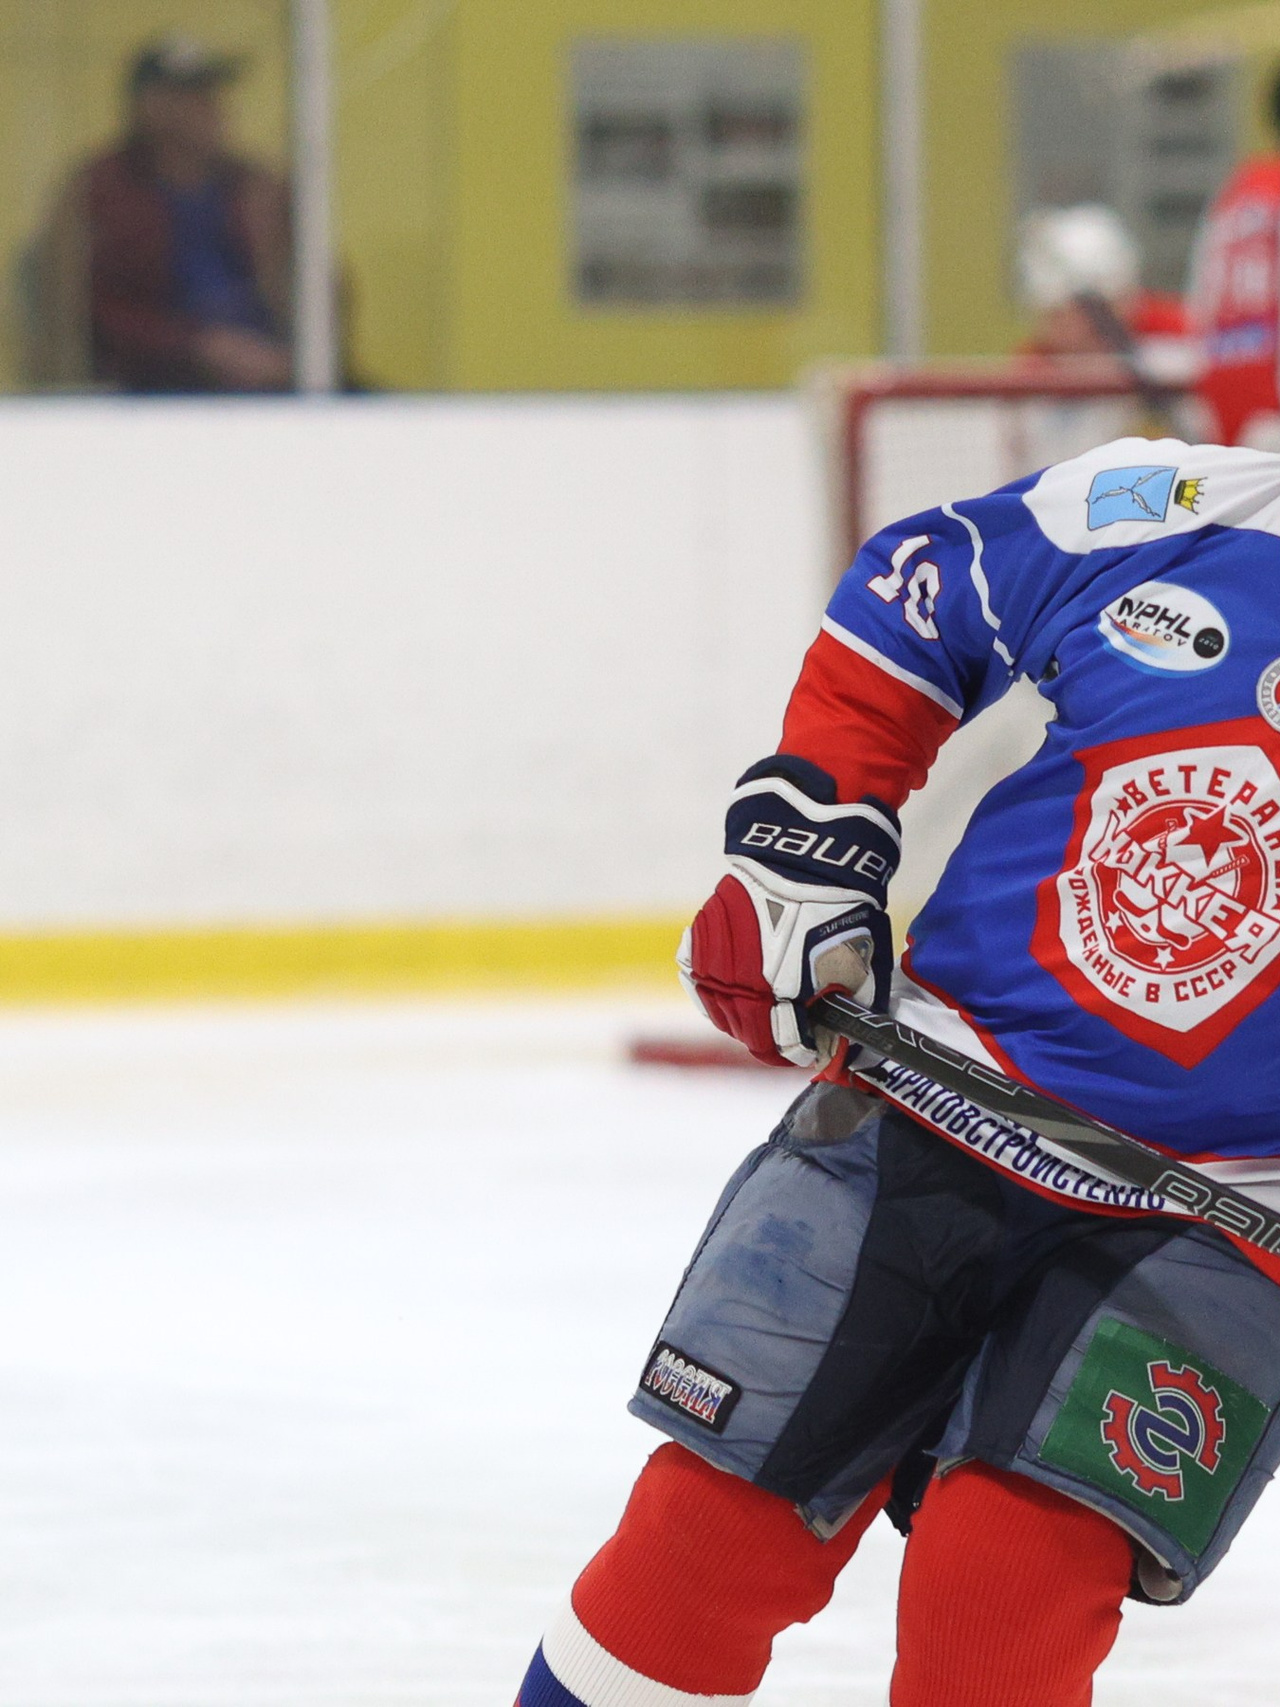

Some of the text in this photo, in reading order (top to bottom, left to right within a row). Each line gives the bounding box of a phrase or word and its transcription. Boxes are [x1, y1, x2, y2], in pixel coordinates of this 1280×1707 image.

[866, 534, 942, 640] 10
[1117, 597, 1192, 639] NPHL
[1067, 866, 1237, 1002] ОЖДЕННЫЕ В СССР
[645, 1348, 733, 1425] РОССИЯ
